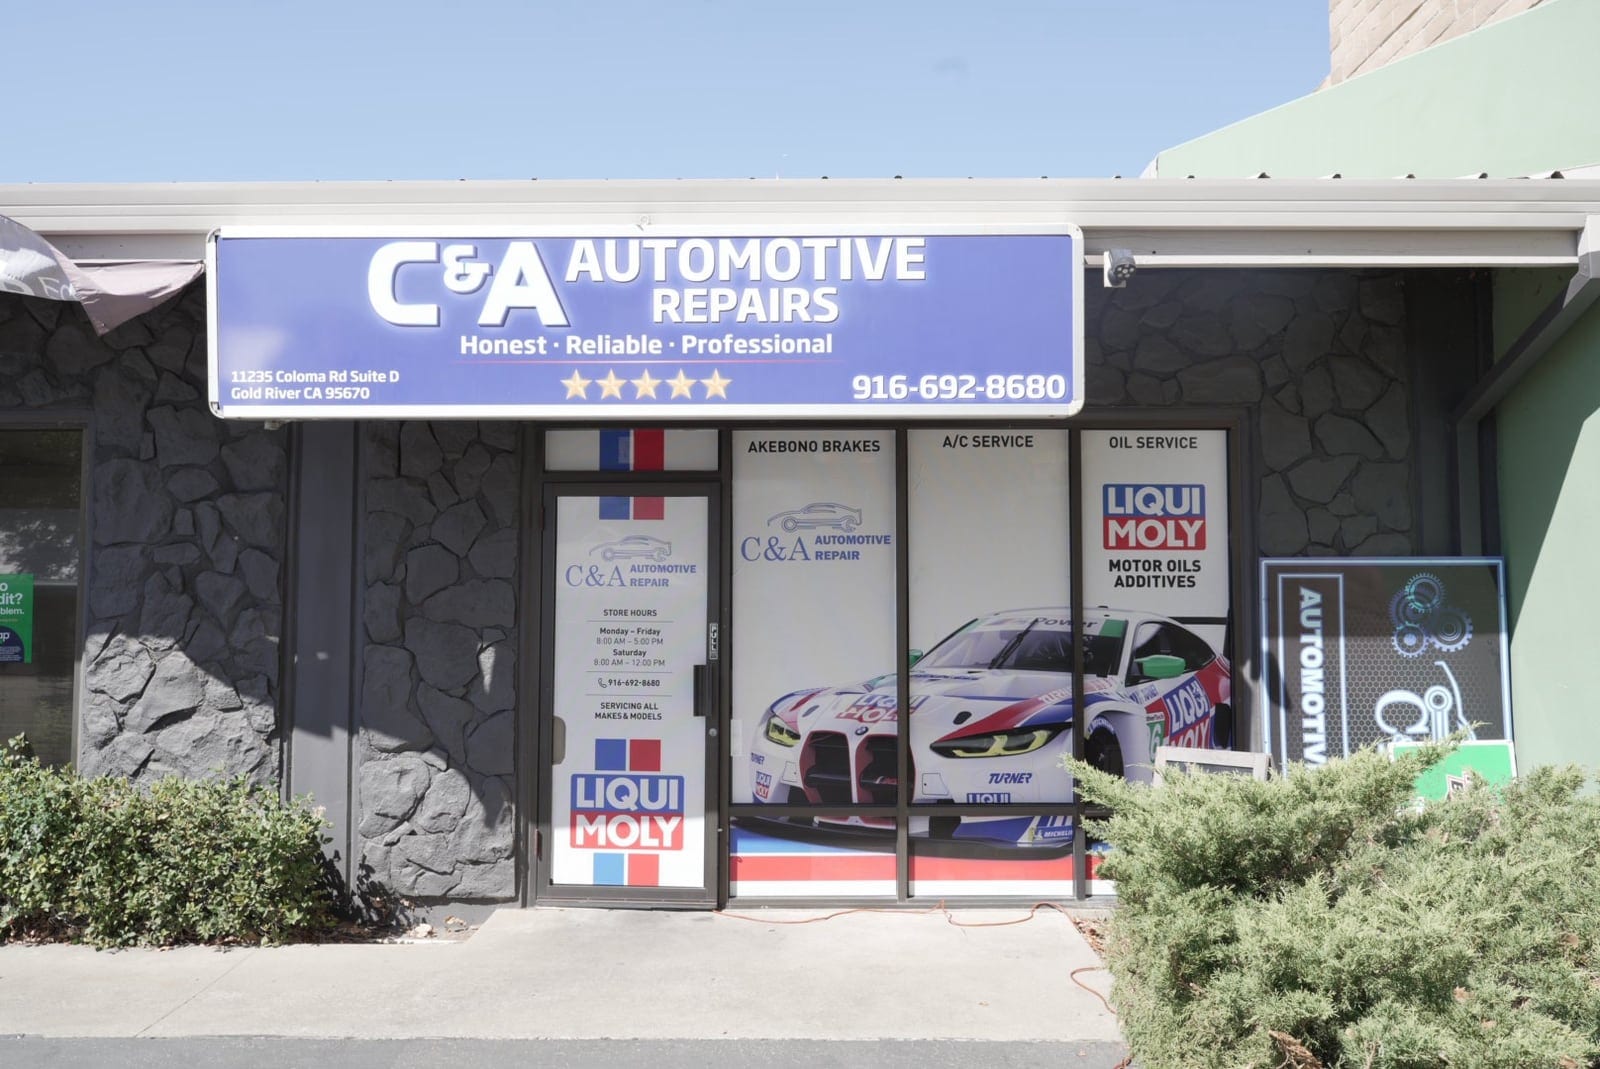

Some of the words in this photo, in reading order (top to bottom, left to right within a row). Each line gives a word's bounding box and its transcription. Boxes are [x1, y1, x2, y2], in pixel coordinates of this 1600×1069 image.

[367, 240, 571, 328] C&A
[564, 237, 927, 283] AUTOMOTIVE
[652, 287, 840, 324] REPAIRS
[460, 334, 548, 356] Honest
[566, 334, 663, 356] Reliable
[681, 333, 833, 355] Professional
[231, 370, 273, 383] 11235
[276, 370, 326, 383] Coloma
[329, 370, 347, 383] Rd
[350, 370, 387, 383] Suite
[389, 370, 400, 383] D
[231, 386, 263, 400] Gold
[265, 386, 301, 399] River
[303, 387, 323, 400] CA
[325, 387, 370, 400] 95670
[852, 374, 1067, 400] 916-692-8680
[748, 441, 818, 453] AKEBONO
[822, 440, 881, 453] BRAKES
[943, 435, 969, 448] A/C
[972, 435, 1034, 448] SERVICE
[1109, 437, 1133, 449] OIL
[1136, 437, 1198, 449] SERVICE
[1108, 487, 1200, 516] LIQUI
[1108, 519, 1204, 547] MOLY
[740, 536, 811, 562] C&A
[815, 535, 892, 545] AUTOMOTIVE
[815, 551, 860, 560] REPAIR
[1108, 560, 1162, 572] MOTOR
[1166, 560, 1201, 572] OILS
[565, 564, 626, 587] C&A
[630, 564, 697, 574] AUTOMOTIVE
[1114, 575, 1196, 588] ADDITIVES
[630, 578, 669, 587] REPAIR
[0, 607, 25, 615] blem.
[603, 609, 629, 617] STORE
[630, 609, 658, 617] HOURS
[599, 627, 629, 636] Monday
[637, 627, 661, 636] Friday
[614, 637, 626, 645] AM
[651, 638, 664, 646] PM
[613, 649, 647, 657] Saturday
[593, 658, 610, 666] 8:00
[632, 659, 652, 667] 12:00
[653, 659, 666, 667] PM
[608, 679, 661, 687] 916-692-8680
[1300, 587, 1328, 769] AUTOMOTIV
[600, 702, 642, 710] SERVICING
[1166, 680, 1208, 733] LIQUI
[630, 712, 662, 720] MODELS
[988, 773, 1032, 784] TURNER
[577, 777, 679, 811] LIQUI
[576, 814, 682, 847] MOLY
